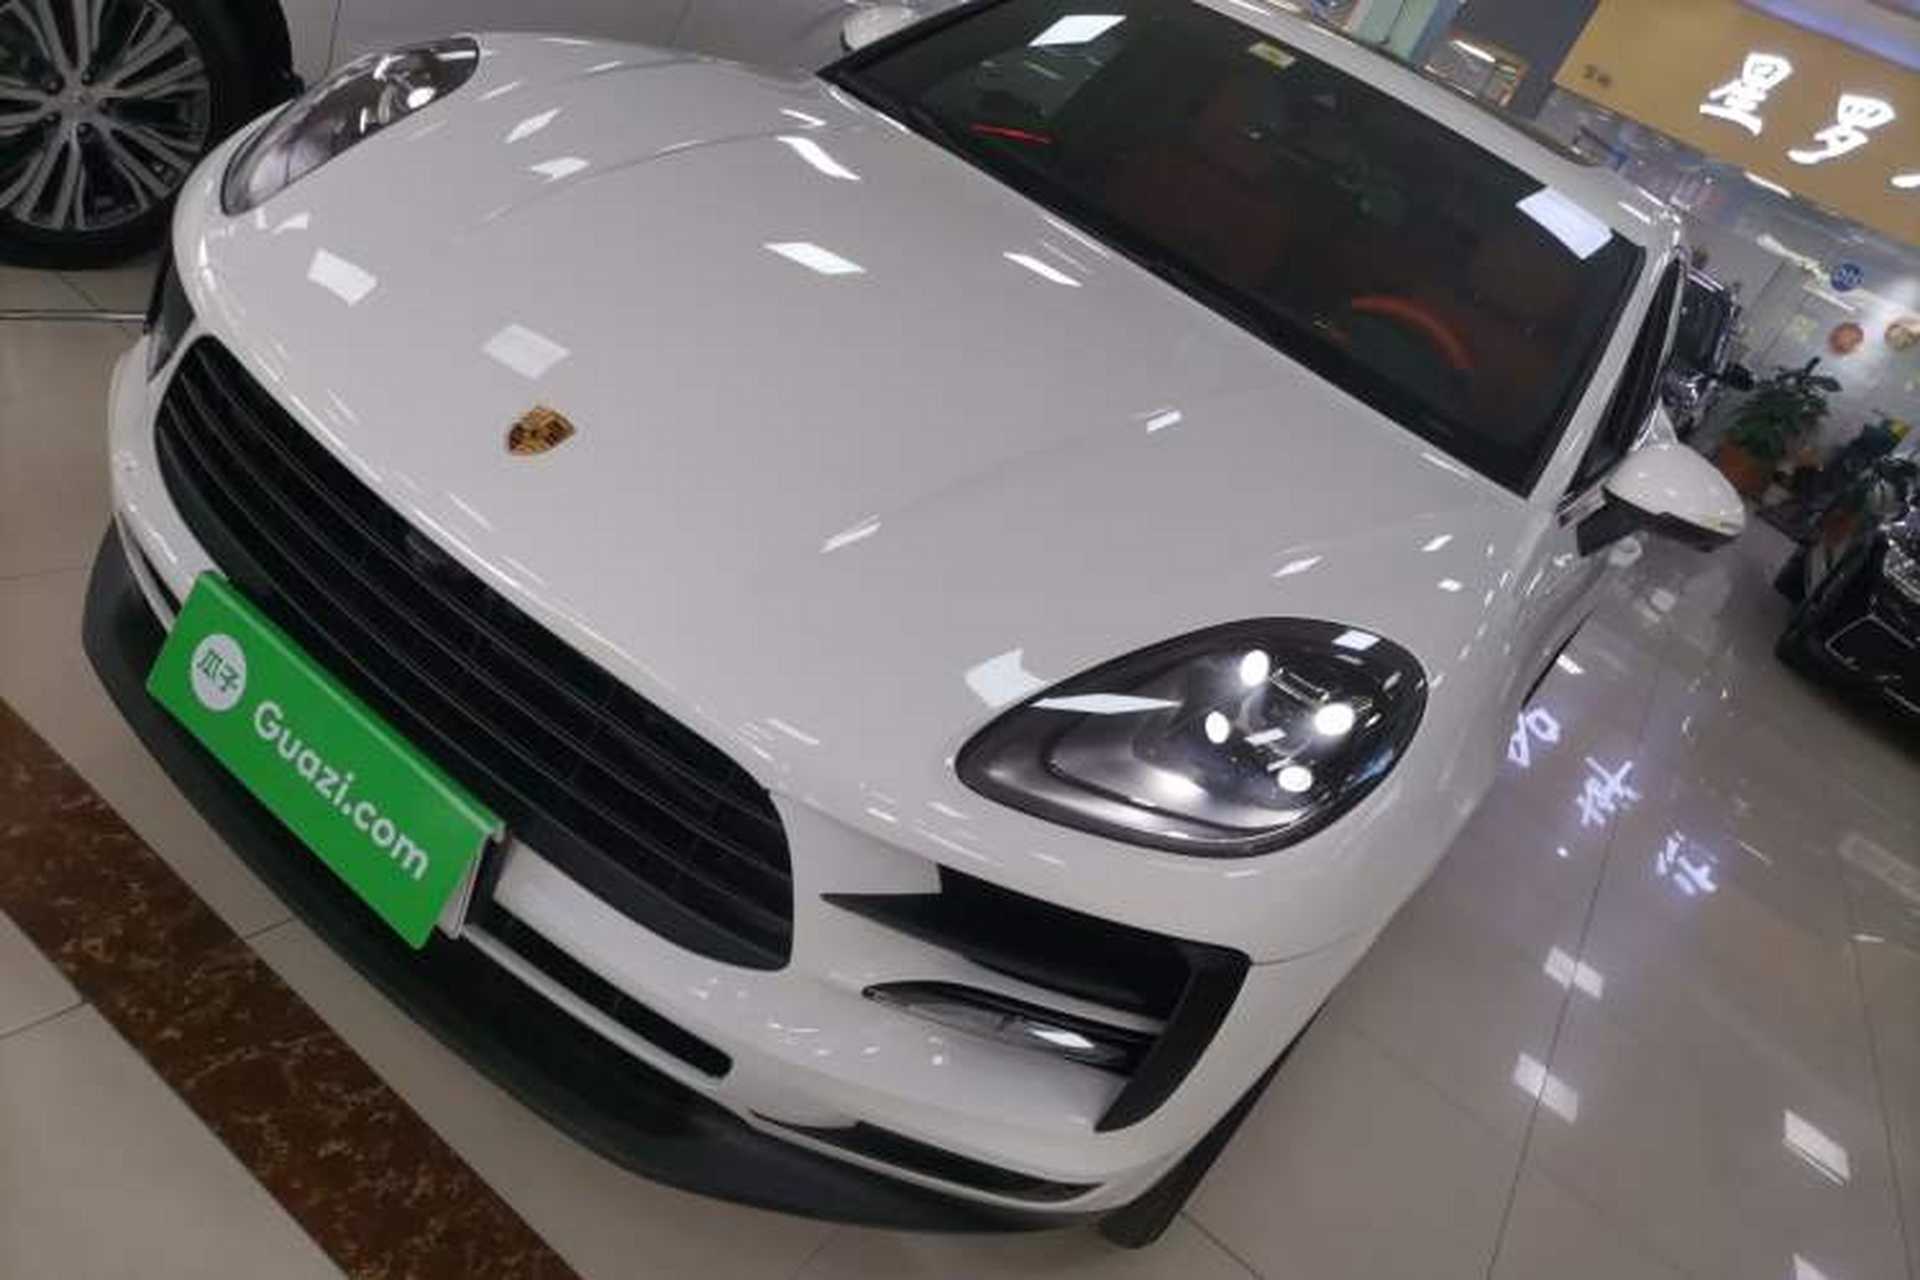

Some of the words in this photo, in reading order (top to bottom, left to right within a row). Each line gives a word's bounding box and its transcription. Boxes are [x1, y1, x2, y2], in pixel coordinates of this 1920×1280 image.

[1700, 53, 1920, 188] 星罗
[197, 648, 239, 692] 瓜子
[253, 701, 429, 880] Guazi.com
